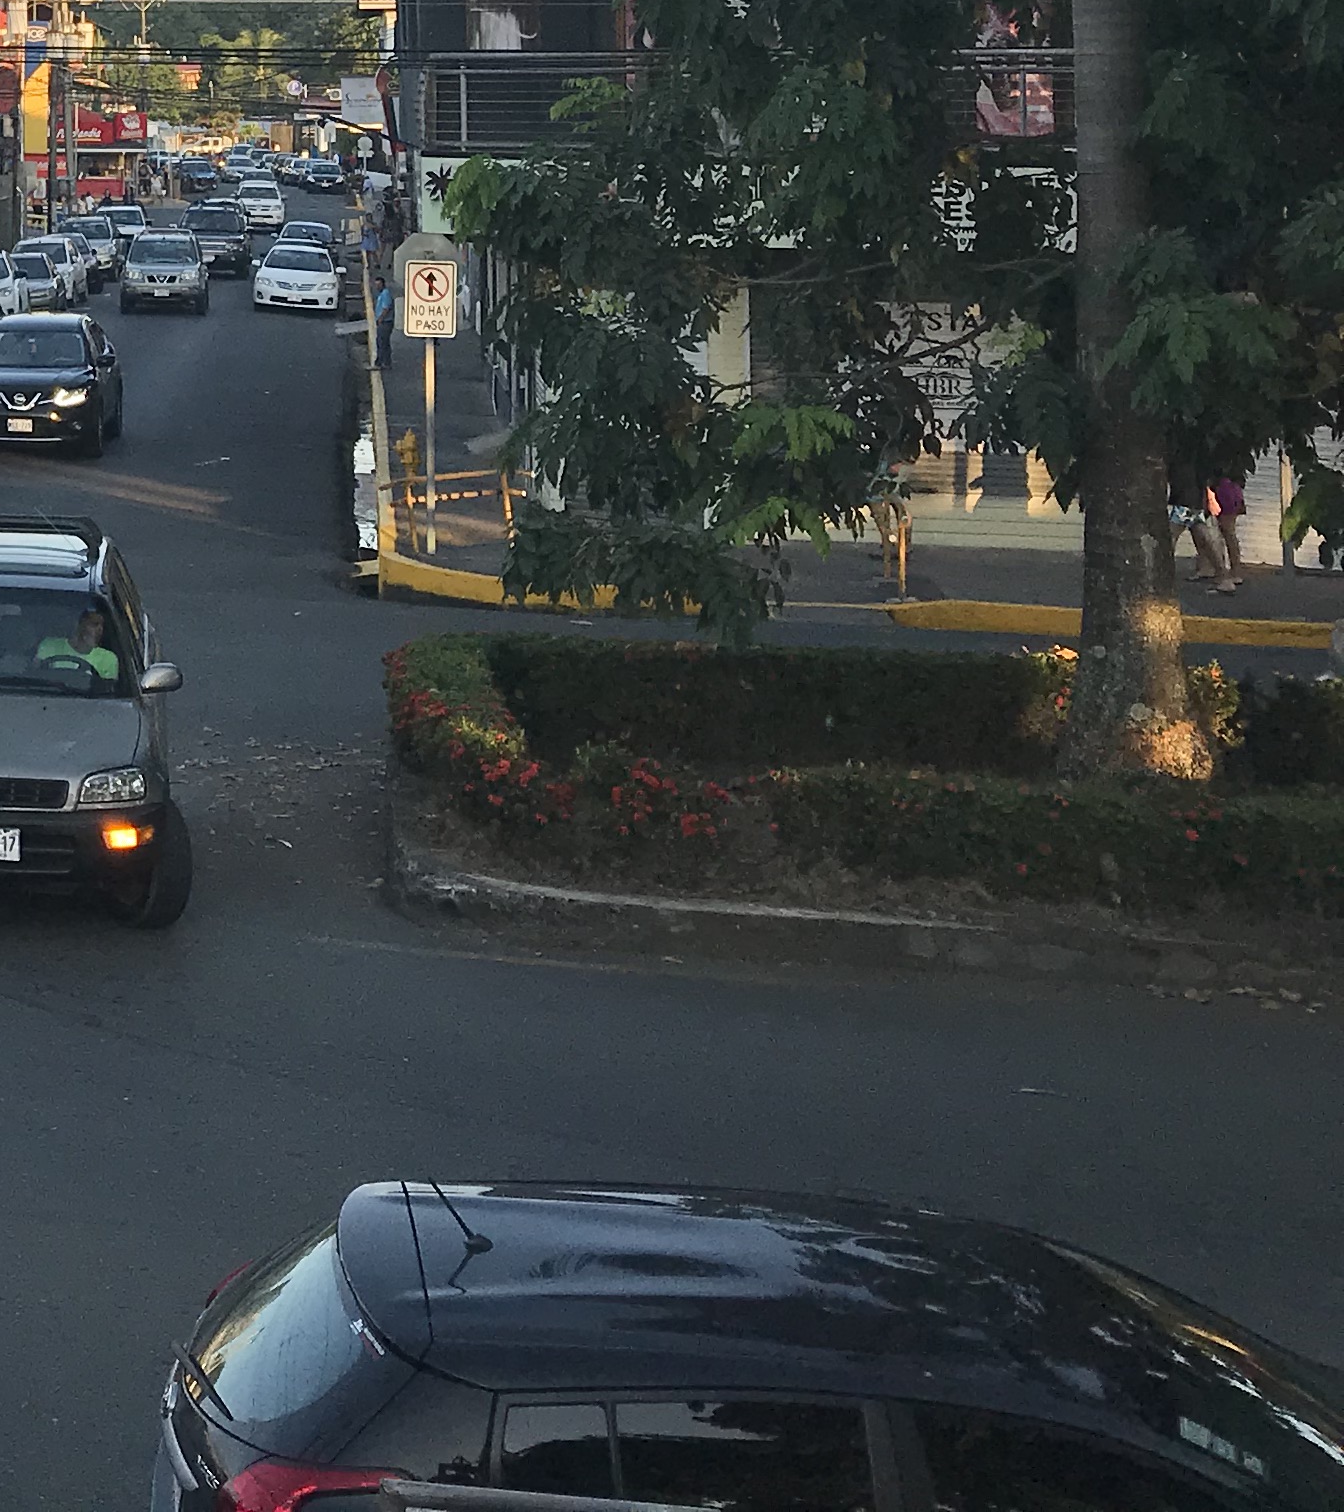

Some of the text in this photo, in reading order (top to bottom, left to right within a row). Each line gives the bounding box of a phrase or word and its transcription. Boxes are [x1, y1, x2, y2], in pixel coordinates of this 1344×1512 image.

[410, 305, 451, 317] NO HAY
[415, 319, 445, 331] PASO
